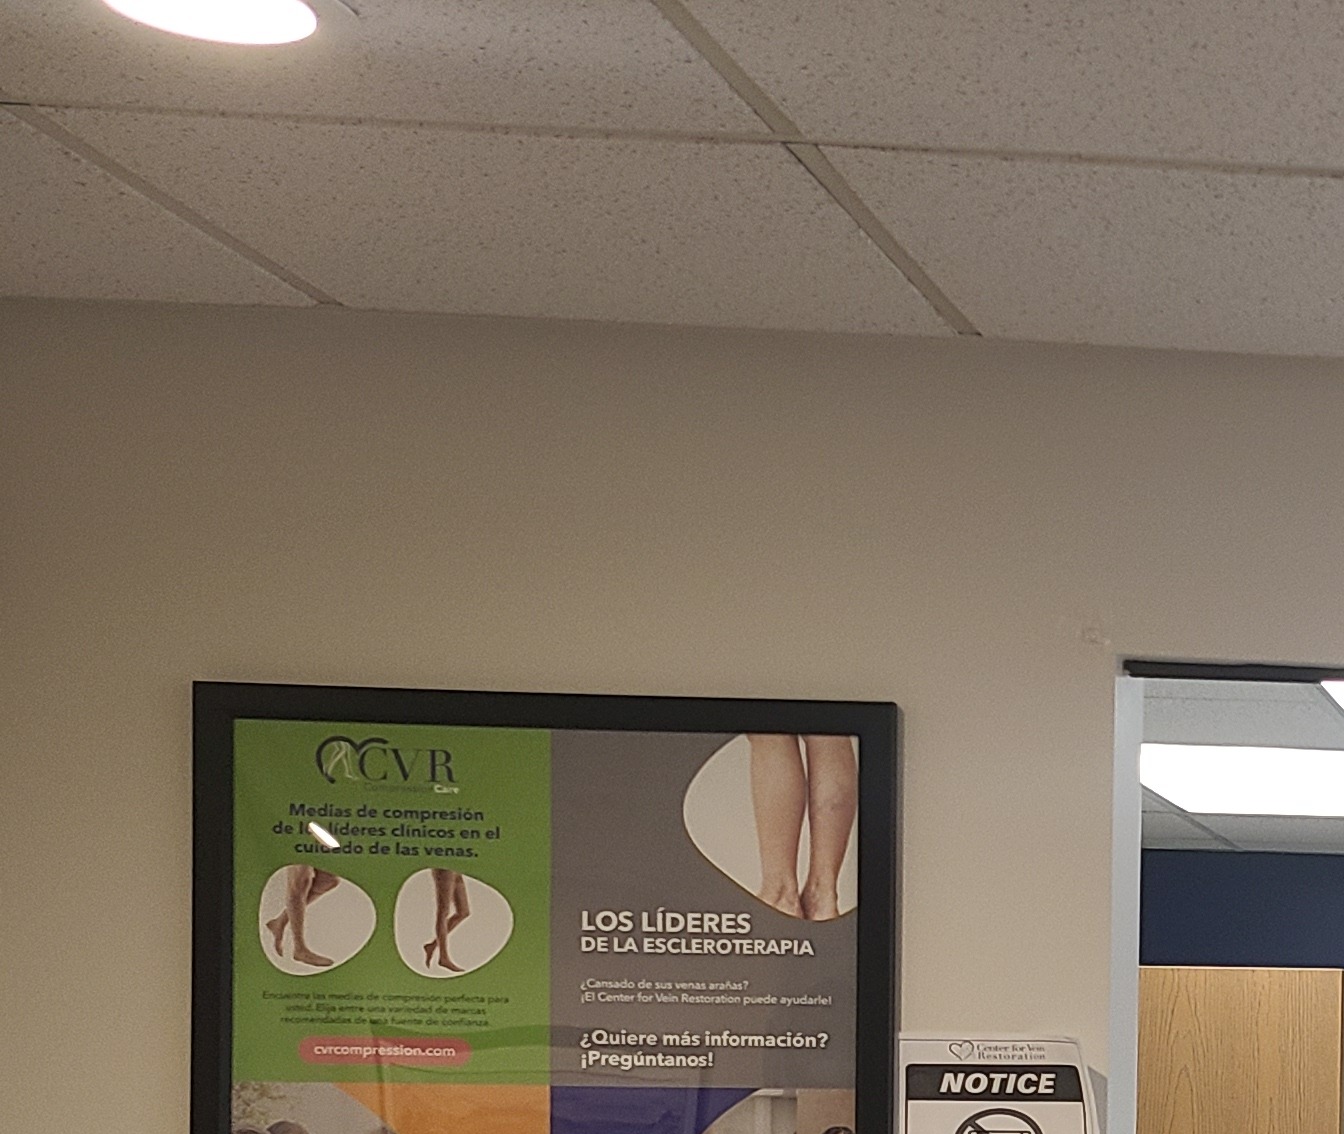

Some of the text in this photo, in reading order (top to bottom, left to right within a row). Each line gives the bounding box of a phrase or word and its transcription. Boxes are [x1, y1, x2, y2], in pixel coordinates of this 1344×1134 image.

[359, 749, 456, 783] CVR
[290, 803, 484, 823] Medias de compresión
[273, 822, 293, 835] de
[391, 823, 454, 839] clínicos
[460, 828, 480, 840] en
[486, 826, 500, 840] el
[369, 843, 391, 855] de
[397, 843, 419, 856] las
[424, 845, 478, 858] venas.
[582, 907, 752, 934] LOS LÍDERES
[581, 937, 814, 956] DE LA ESCLEROTERAPIA
[580, 978, 635, 991] ¿Cansado
[638, 980, 652, 990] de
[655, 982, 672, 990] sus
[675, 982, 707, 990] venas
[598, 992, 634, 1002] Center
[638, 993, 652, 1002] for
[656, 993, 678, 1003] Vein
[681, 994, 741, 1004] Restoration
[743, 995, 777, 1007] puede
[780, 996, 832, 1007] ayudarle!
[580, 1030, 828, 1049] ¿Quiere más información?
[314, 1045, 456, 1059] cvrcompression.com
[581, 1051, 714, 1070] ¡Pregúntanos!
[940, 1072, 1056, 1094] NOTICE
